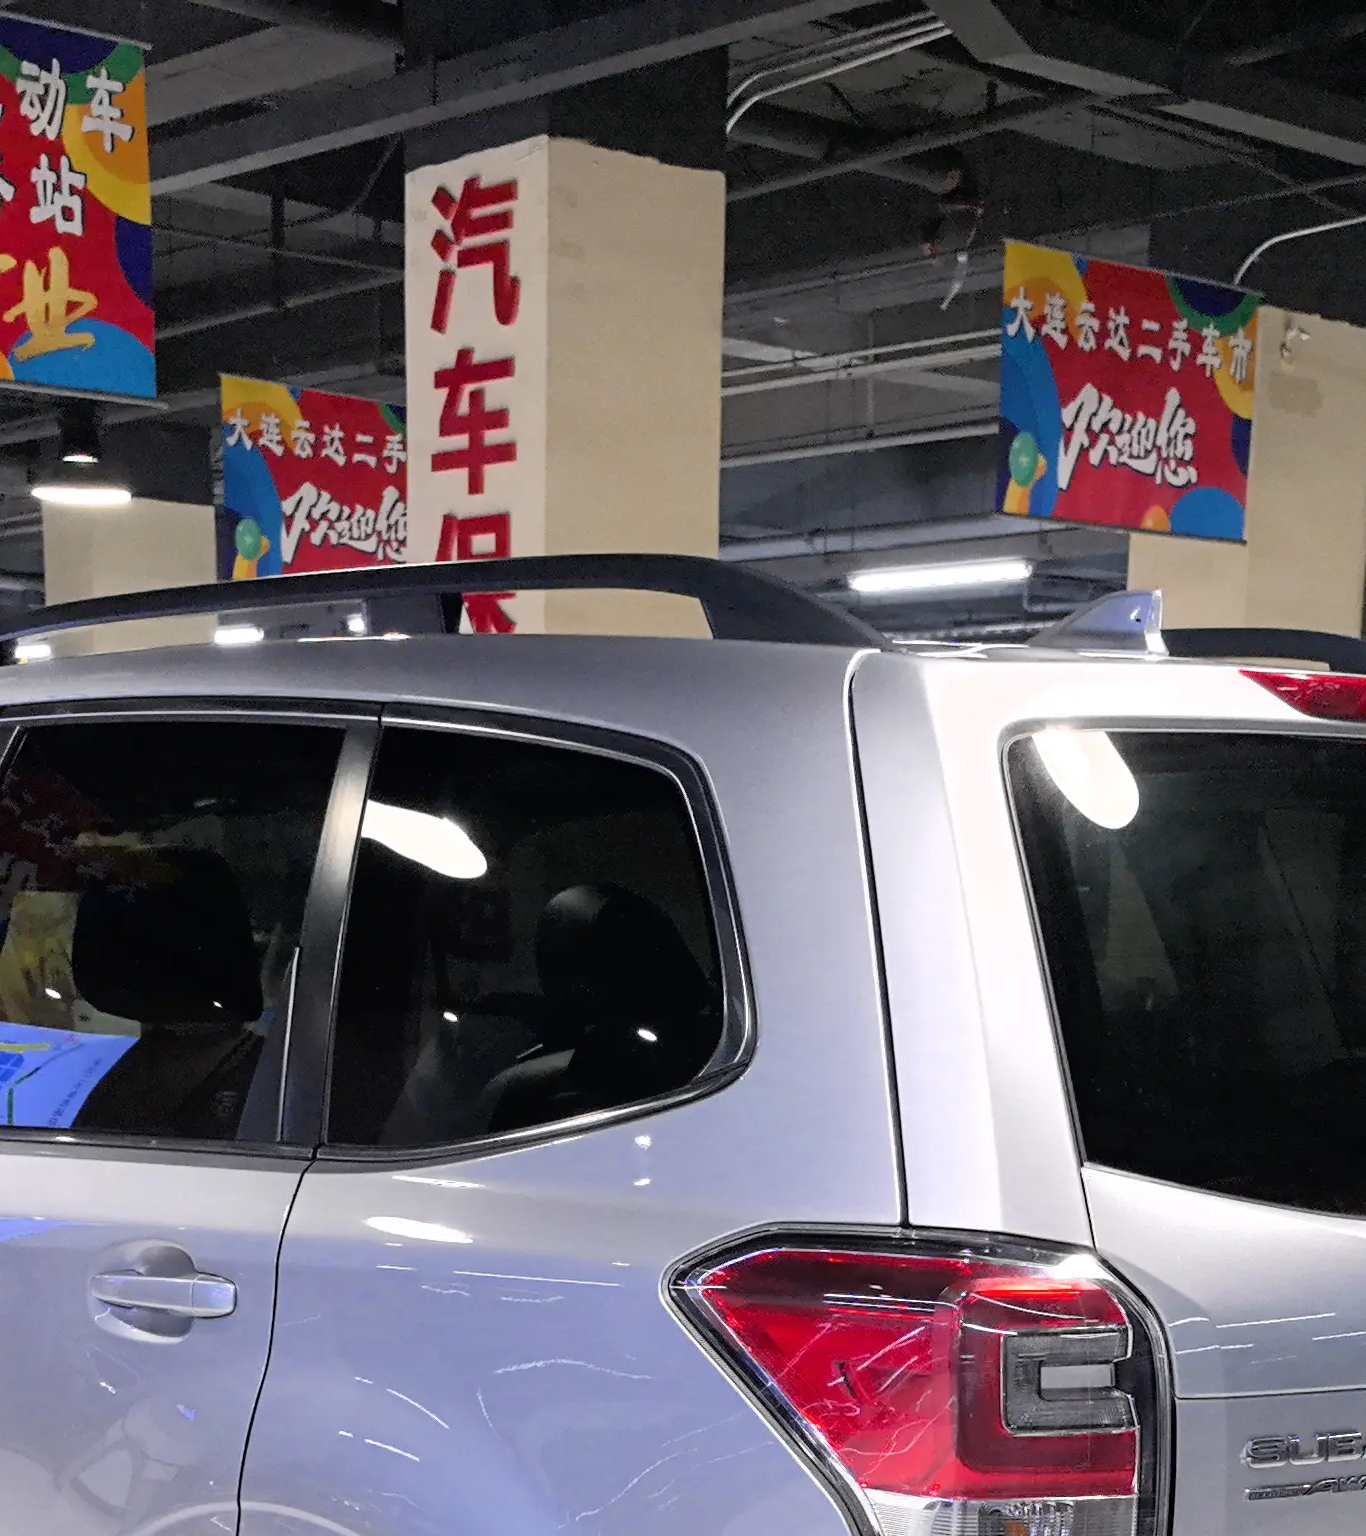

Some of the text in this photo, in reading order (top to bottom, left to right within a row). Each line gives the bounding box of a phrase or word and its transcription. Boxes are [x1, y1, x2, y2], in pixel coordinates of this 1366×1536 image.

[225, 408, 407, 474] 大连云达二手
[1058, 382, 1198, 491] 欢迎您
